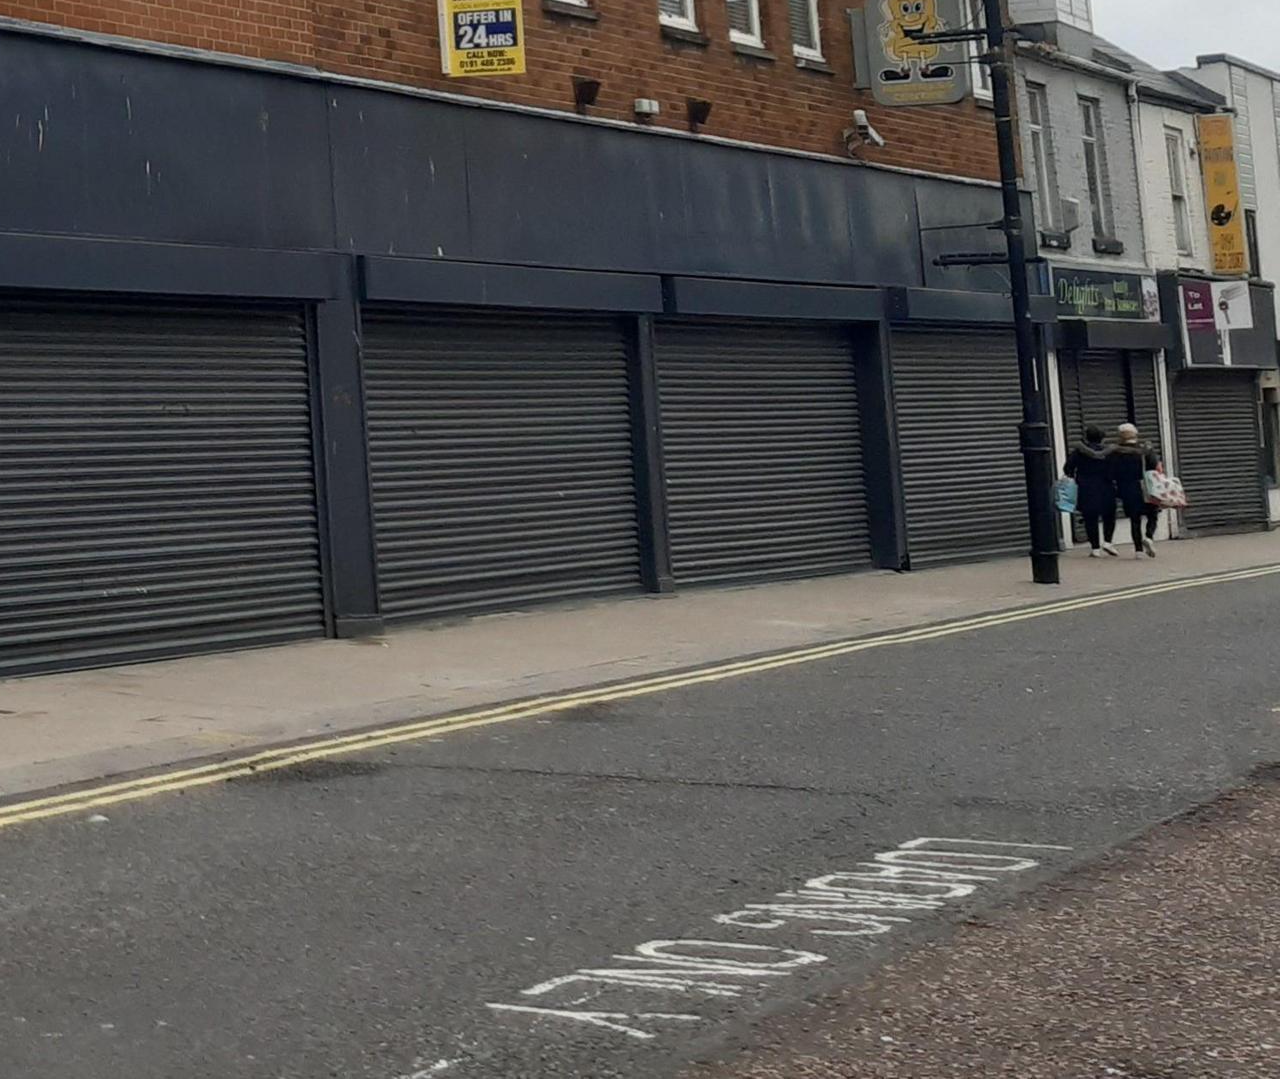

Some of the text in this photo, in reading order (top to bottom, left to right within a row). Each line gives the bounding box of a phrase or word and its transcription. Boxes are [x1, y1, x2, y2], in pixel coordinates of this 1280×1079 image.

[457, 9, 512, 25] OFFER IN
[458, 25, 514, 48] 24 HRS
[466, 51, 485, 59] CALL
[1058, 276, 1100, 315] Delights
[485, 938, 828, 1039] ONLY
